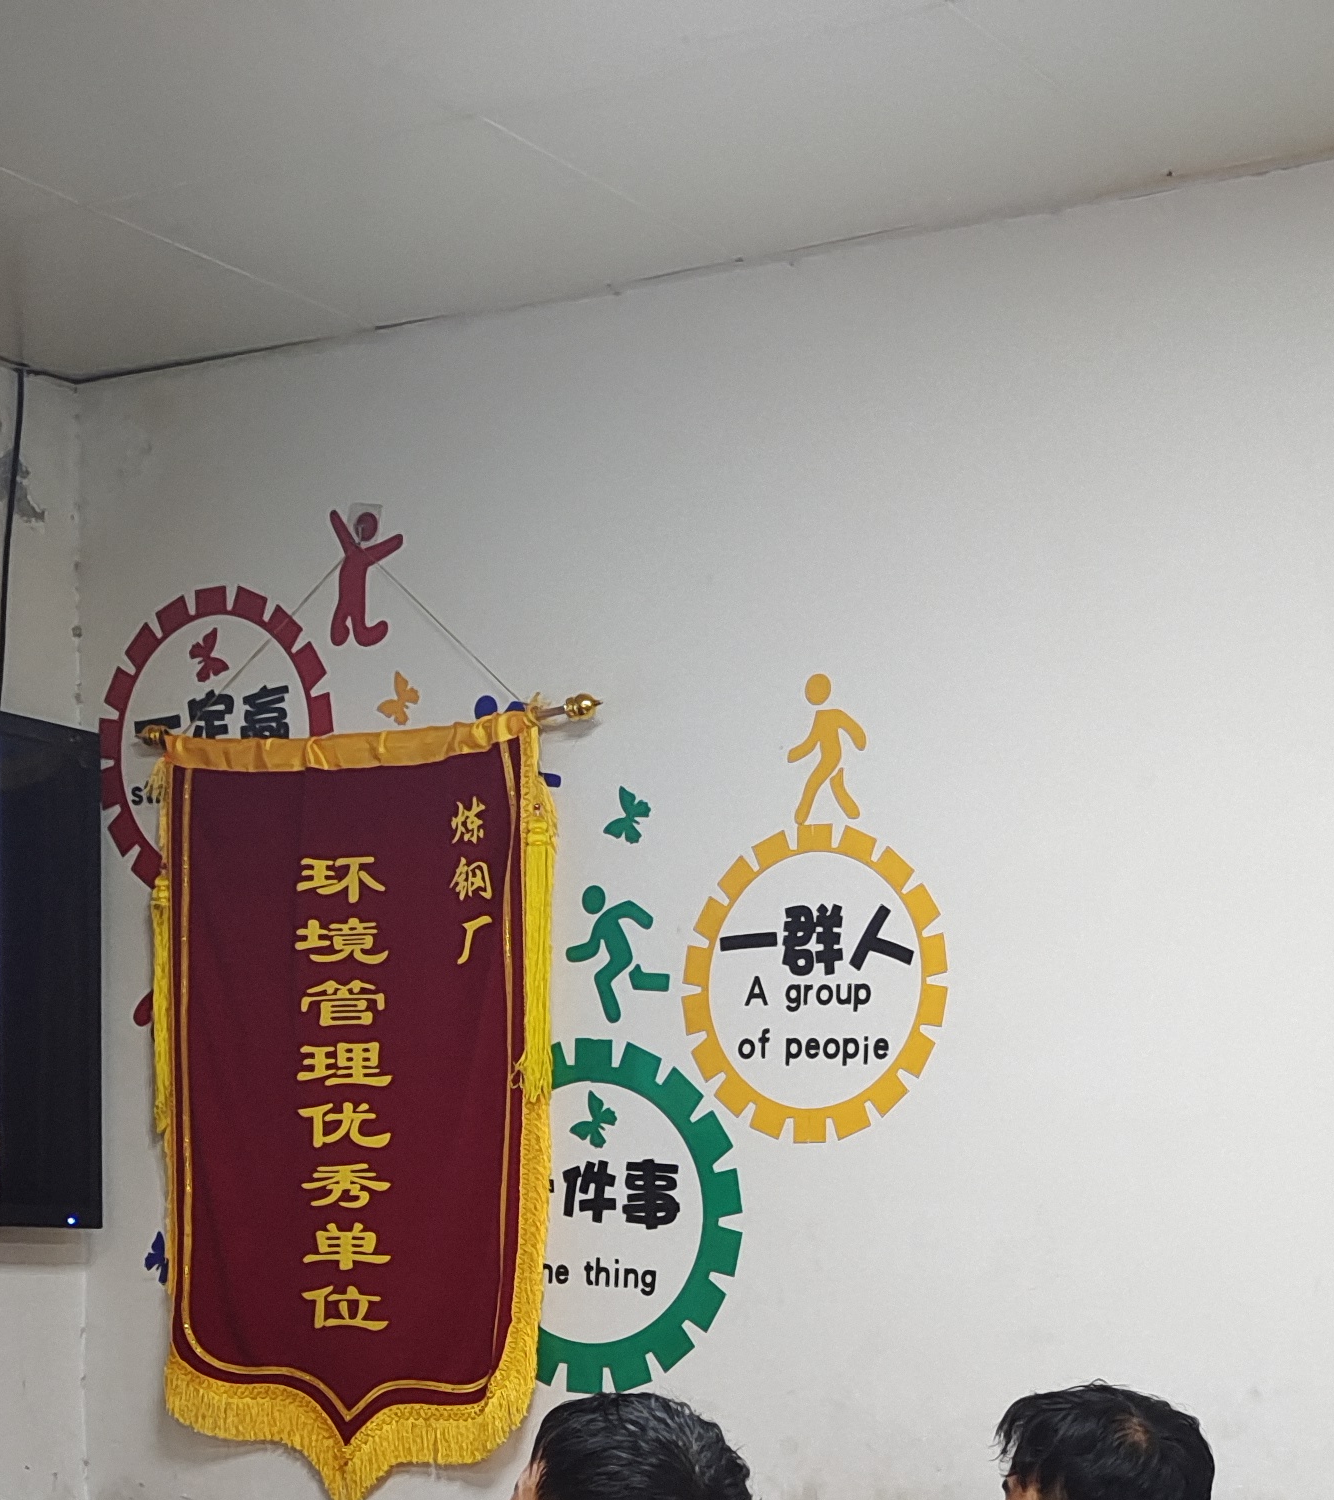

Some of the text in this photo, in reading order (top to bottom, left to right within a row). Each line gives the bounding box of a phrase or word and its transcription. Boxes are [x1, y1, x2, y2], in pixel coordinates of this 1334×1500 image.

[450, 797, 493, 966] 炼钢厂
[719, 903, 915, 976] 一群人
[745, 977, 872, 1012] A group
[737, 1032, 771, 1060] of
[295, 855, 393, 1333] 环境管理优秀单位
[549, 1158, 681, 1231] 件事
[543, 1257, 657, 1296] ne thing
